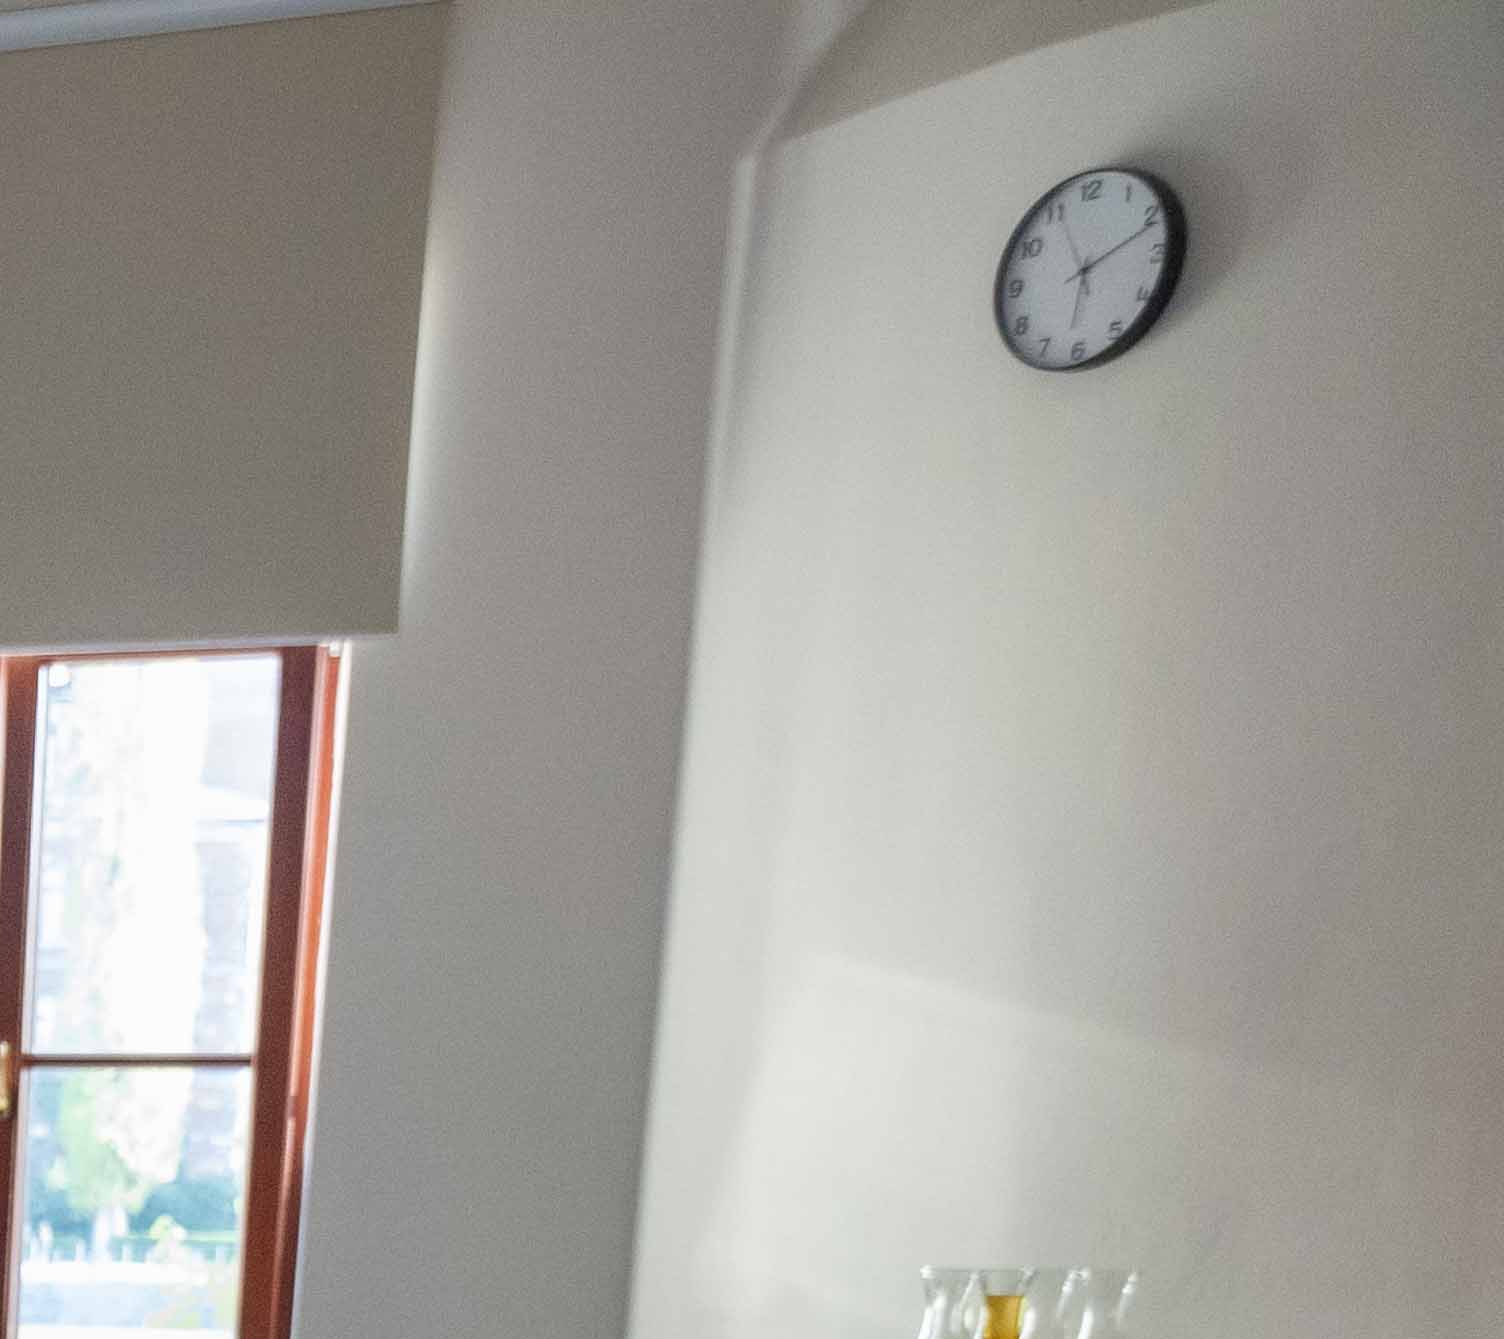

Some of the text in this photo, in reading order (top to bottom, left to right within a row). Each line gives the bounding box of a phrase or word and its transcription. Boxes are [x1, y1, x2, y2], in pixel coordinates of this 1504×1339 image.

[1081, 180, 1103, 202] 12
[1124, 184, 1133, 203] 1
[1047, 203, 1065, 223] 11
[1144, 205, 1159, 226] 2
[1021, 237, 1044, 258] 10
[1149, 243, 1166, 265] 3
[1007, 279, 1025, 298] 9
[1135, 286, 1150, 302] 4
[1014, 315, 1029, 336] 8
[1107, 321, 1125, 341] 5
[1038, 336, 1052, 359] 7
[1071, 341, 1089, 361] 6
